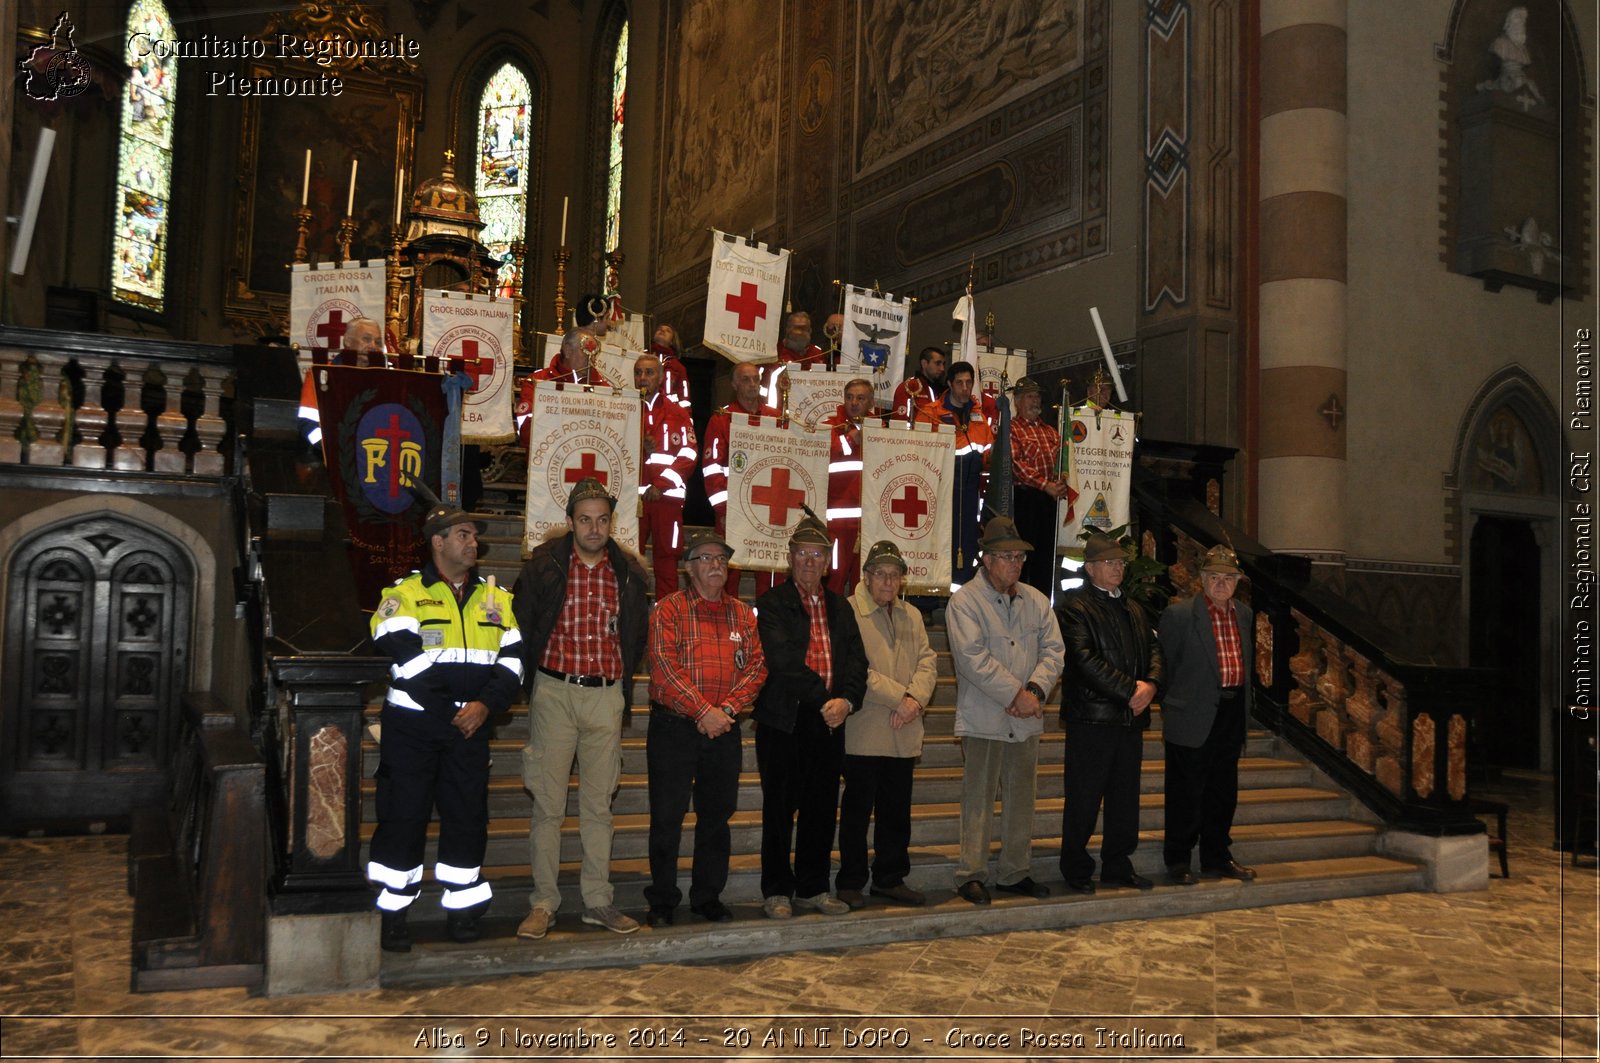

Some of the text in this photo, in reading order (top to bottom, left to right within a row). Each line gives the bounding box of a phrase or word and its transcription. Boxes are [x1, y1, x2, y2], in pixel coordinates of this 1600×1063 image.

[304, 272, 373, 283] CROCE ROSSA
[316, 285, 360, 295] ITALIANA
[430, 304, 509, 319] CROCE ROSSA ITALIANA
[720, 332, 766, 354] SUZZARA
[812, 388, 843, 400] ROSSA
[561, 396, 594, 406] VOLONTARI
[597, 400, 607, 408] DEL
[610, 402, 636, 412] SOCCORSO
[461, 412, 483, 422] LBA
[562, 407, 596, 417] FEMMINILE
[735, 432, 754, 440] CORPO
[788, 437, 798, 446] DEL
[887, 438, 916, 446] VOLONTARI
[533, 420, 636, 475] CROCE ROSSA ITALIANA
[731, 440, 830, 458] CROCE ROSSA ITALIANA
[1074, 447, 1107, 457] TEGGERE
[550, 454, 567, 506] NVENZIONE
[562, 444, 572, 453] DI
[574, 437, 611, 456] GINEVRA
[611, 470, 620, 498] AGOST
[744, 458, 784, 484] CONVENZIONE
[872, 458, 894, 480] CROCE
[896, 454, 920, 463] ROSSA
[899, 476, 924, 486] GINEVRA
[1084, 480, 1112, 492] ALBA
[535, 521, 568, 530] COMIT
[743, 538, 778, 549] COMITATO
[748, 548, 790, 560] MORET
[916, 552, 938, 560] LOCALE
[908, 566, 928, 576] NEO
